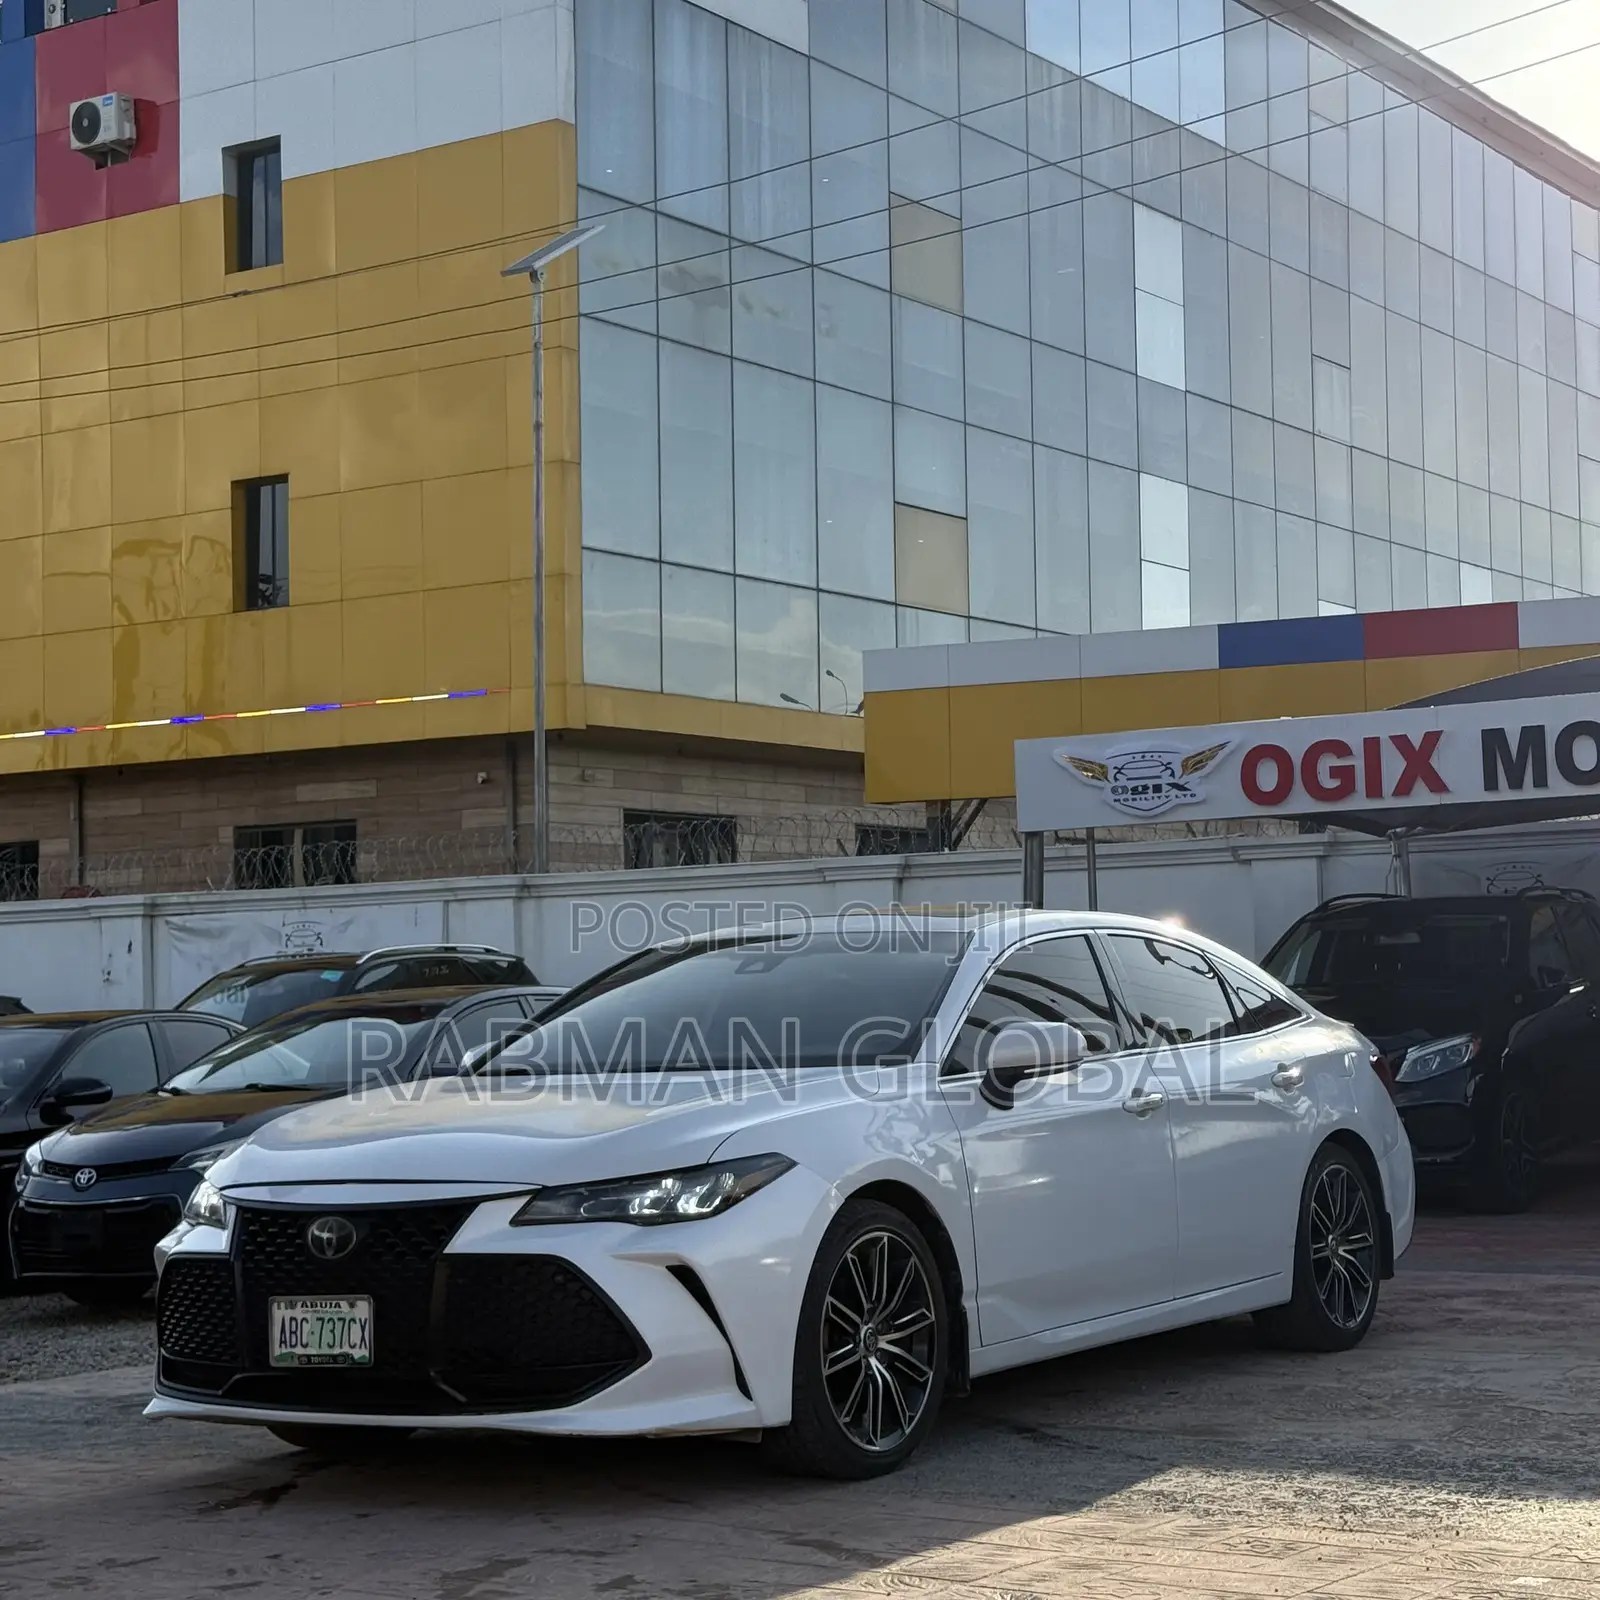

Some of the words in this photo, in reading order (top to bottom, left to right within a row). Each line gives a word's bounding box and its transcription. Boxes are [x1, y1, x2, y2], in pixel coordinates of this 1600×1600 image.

[1240, 730, 1451, 806] OGIX
[1481, 720, 1600, 793] MO
[1113, 795, 1171, 803] MOBILITY
